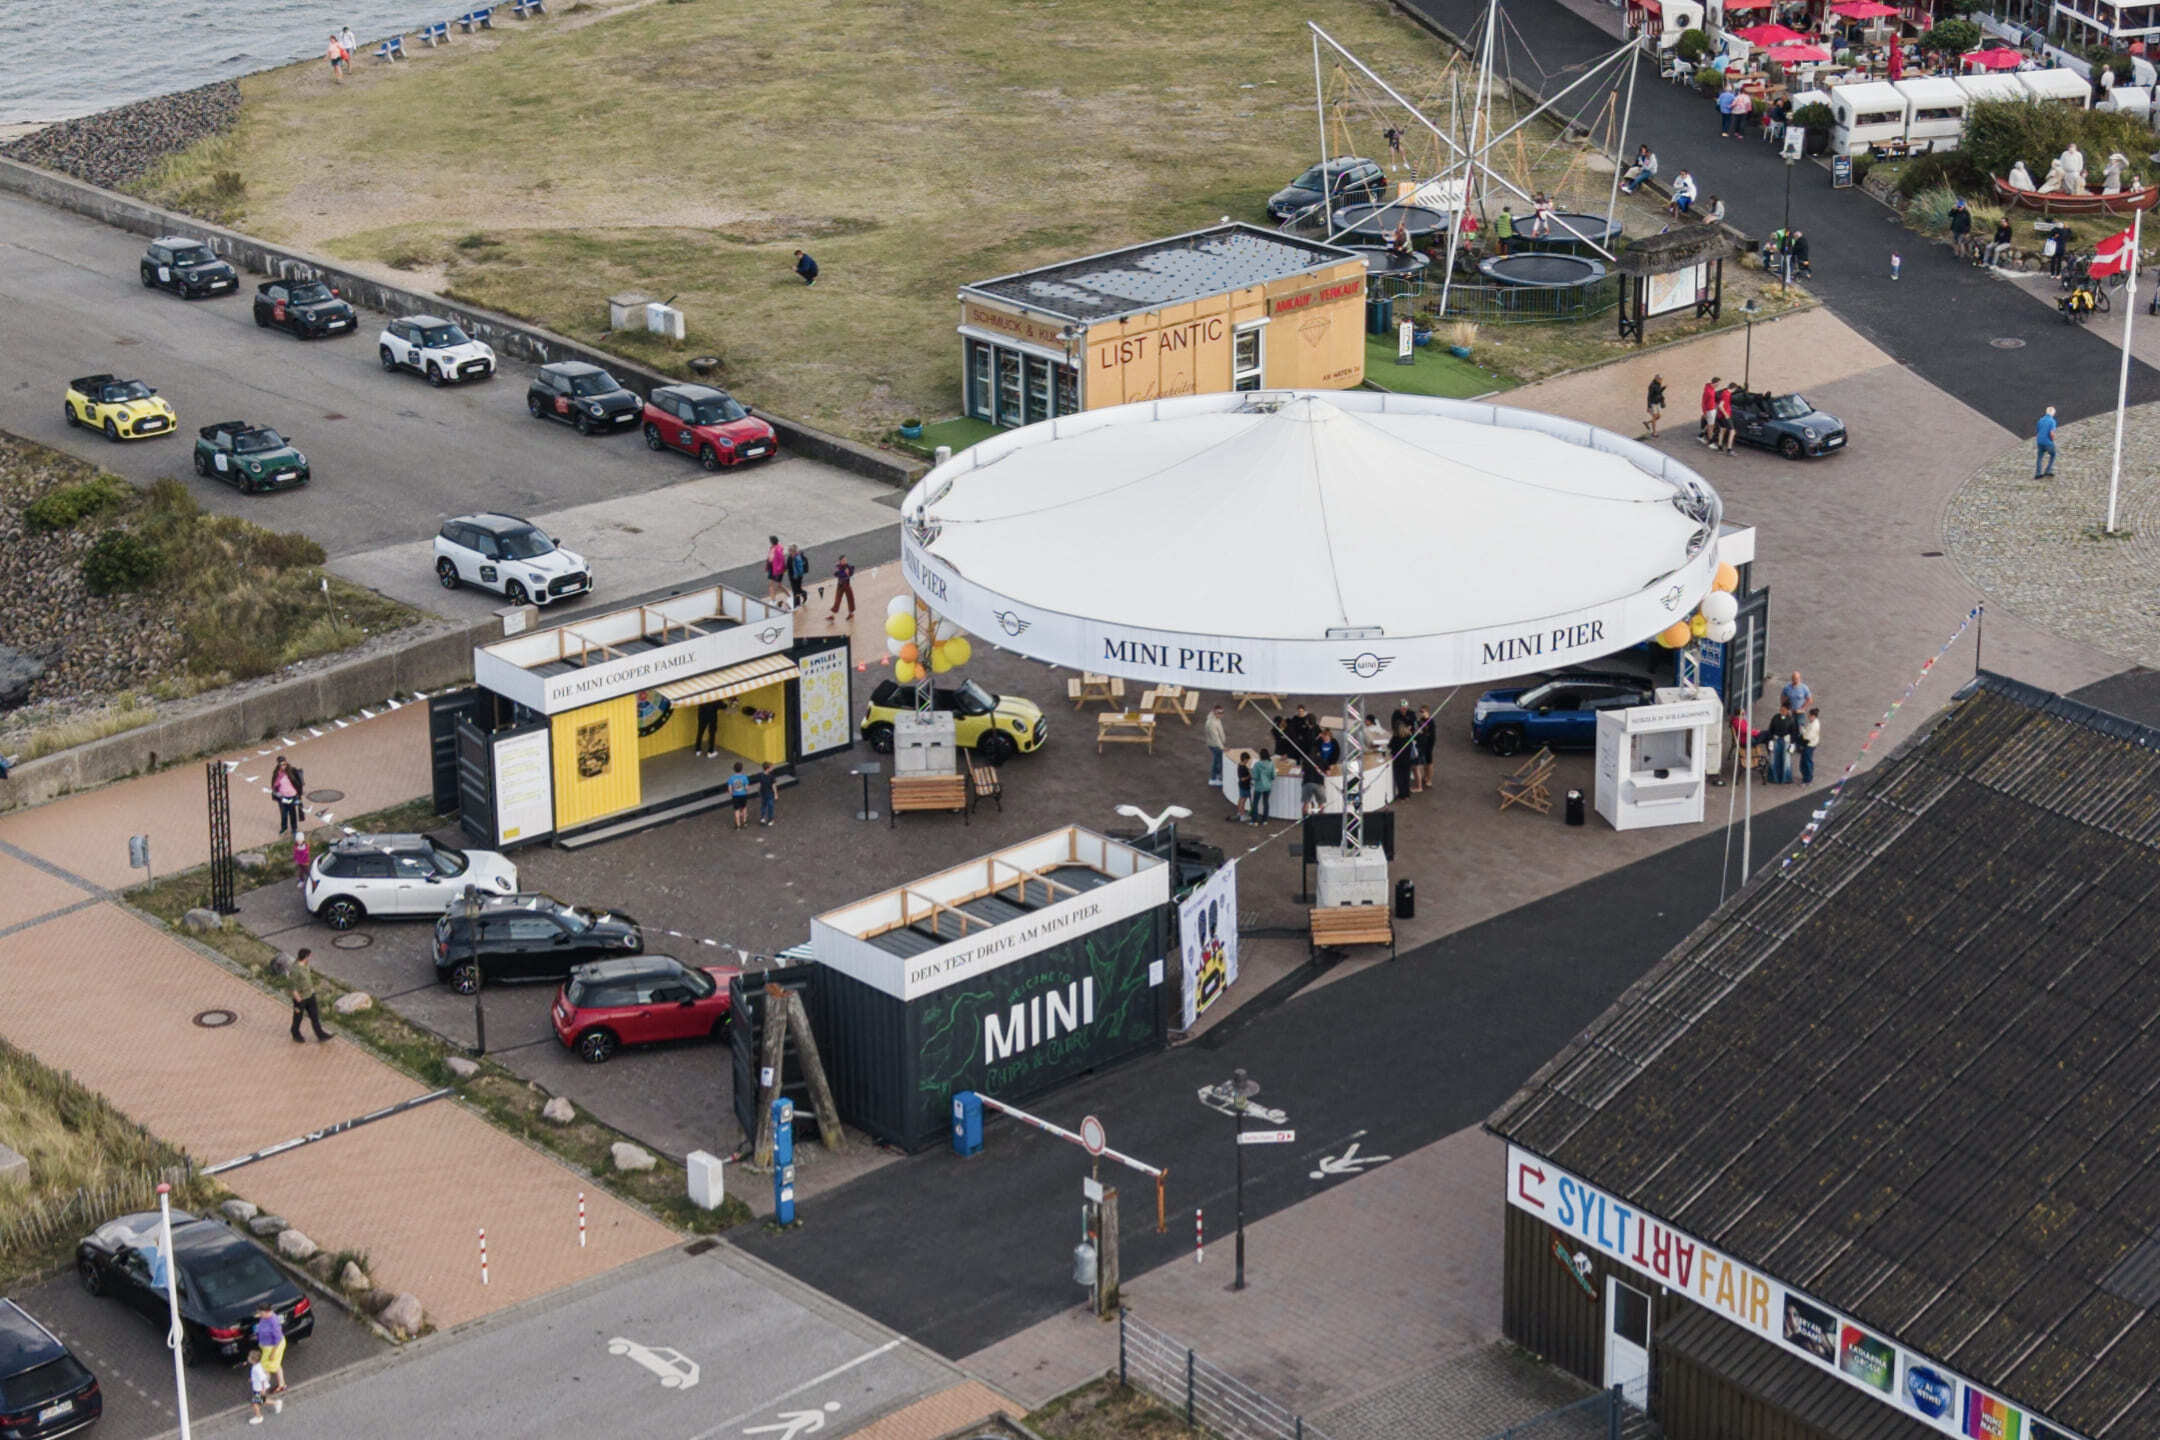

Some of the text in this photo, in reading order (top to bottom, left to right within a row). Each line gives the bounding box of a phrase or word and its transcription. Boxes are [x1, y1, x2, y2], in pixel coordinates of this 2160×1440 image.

[973, 309, 1021, 332] SCHMUCK
[1026, 324, 1033, 337] &
[1101, 336, 1147, 369] LIST
[1160, 318, 1223, 352] ANTIC
[922, 564, 948, 603] PIER
[1104, 637, 1246, 675] MINI PIER
[1482, 619, 1605, 665] MINI PIER
[552, 684, 574, 700] DIE
[576, 677, 604, 695] MINI
[606, 664, 650, 686] COOPER
[911, 962, 942, 985] DEIN
[944, 951, 975, 973] TEST
[976, 935, 1016, 960] DRIVE
[1018, 928, 1039, 944] AM
[1041, 915, 1069, 934] MINI
[985, 976, 1093, 1065] MINI
[1557, 1175, 1632, 1255] SYLT
[1700, 1250, 1770, 1331] FAIR
